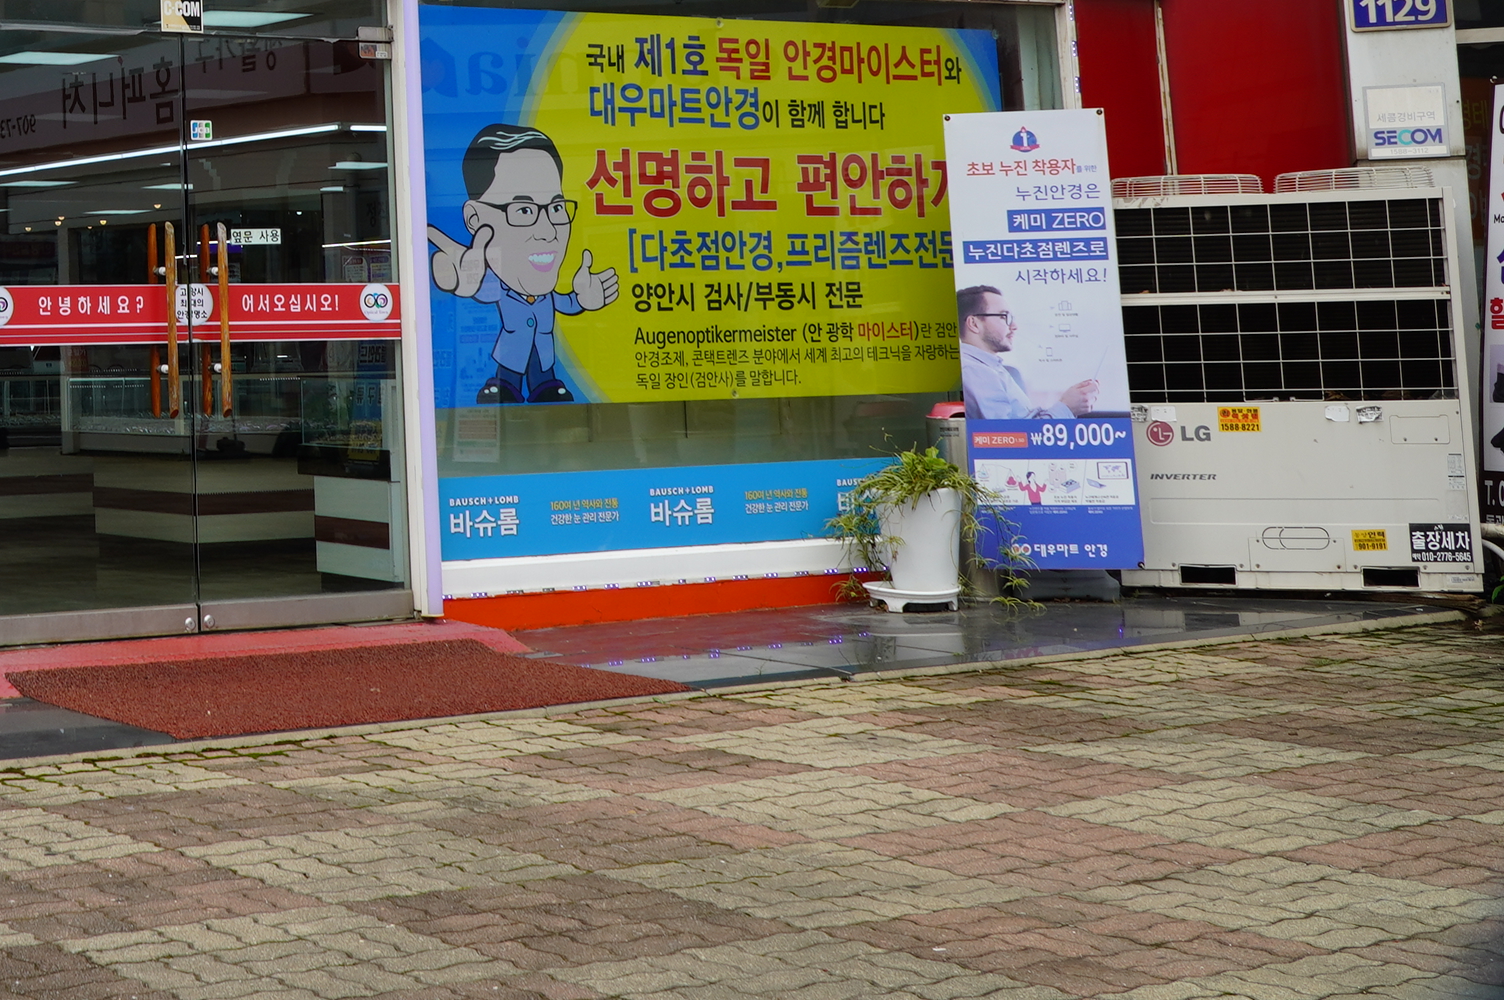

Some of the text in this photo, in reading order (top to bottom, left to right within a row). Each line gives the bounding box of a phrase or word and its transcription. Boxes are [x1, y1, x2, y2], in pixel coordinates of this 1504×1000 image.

[586, 33, 962, 86] 국내 제1호 독일 안경마이스터와
[589, 83, 886, 131] 대우마트안경이 함께 합니다
[1373, 128, 1443, 146] SECOM
[966, 161, 995, 176] 초보
[999, 159, 1028, 176] 누진
[1032, 158, 1082, 176] 착용자를
[585, 148, 778, 218] 선명하고
[1015, 183, 1101, 201] 누진안경은
[1013, 211, 1105, 230] 케미 ZERO
[232, 229, 280, 243] 옆문 사용
[968, 241, 1107, 260] 누진다초점렌즈로
[1015, 267, 1107, 285] 시작하세요!
[38, 295, 144, 315] 안녕하세요?
[242, 294, 339, 312] 어서오십시오!
[632, 280, 864, 312] 양안시 검사/부동시 전문
[634, 324, 797, 349] Augenoptikermeister
[802, 322, 822, 344] (안
[826, 321, 854, 343] 광학
[634, 344, 959, 368] 안경조제, 콘택트렌즈 분야에서 세계 최고의 테크닉을 자랑하는
[636, 368, 802, 390] 독일 장인(검안사)를 말합니다.
[1181, 425, 1211, 442] LG
[1220, 423, 1260, 432] 1588-8221
[991, 436, 1015, 444] ZERO
[1149, 472, 1218, 481] INVERTER
[649, 485, 714, 497] BAUSCH+LOMB
[449, 495, 519, 507] BAUSCH+LOMB
[649, 497, 715, 527] 바슈롬
[449, 508, 520, 538] 바슈롬
[1411, 531, 1471, 551] 출장세차
[1034, 543, 1108, 558] 대우마트 안경
